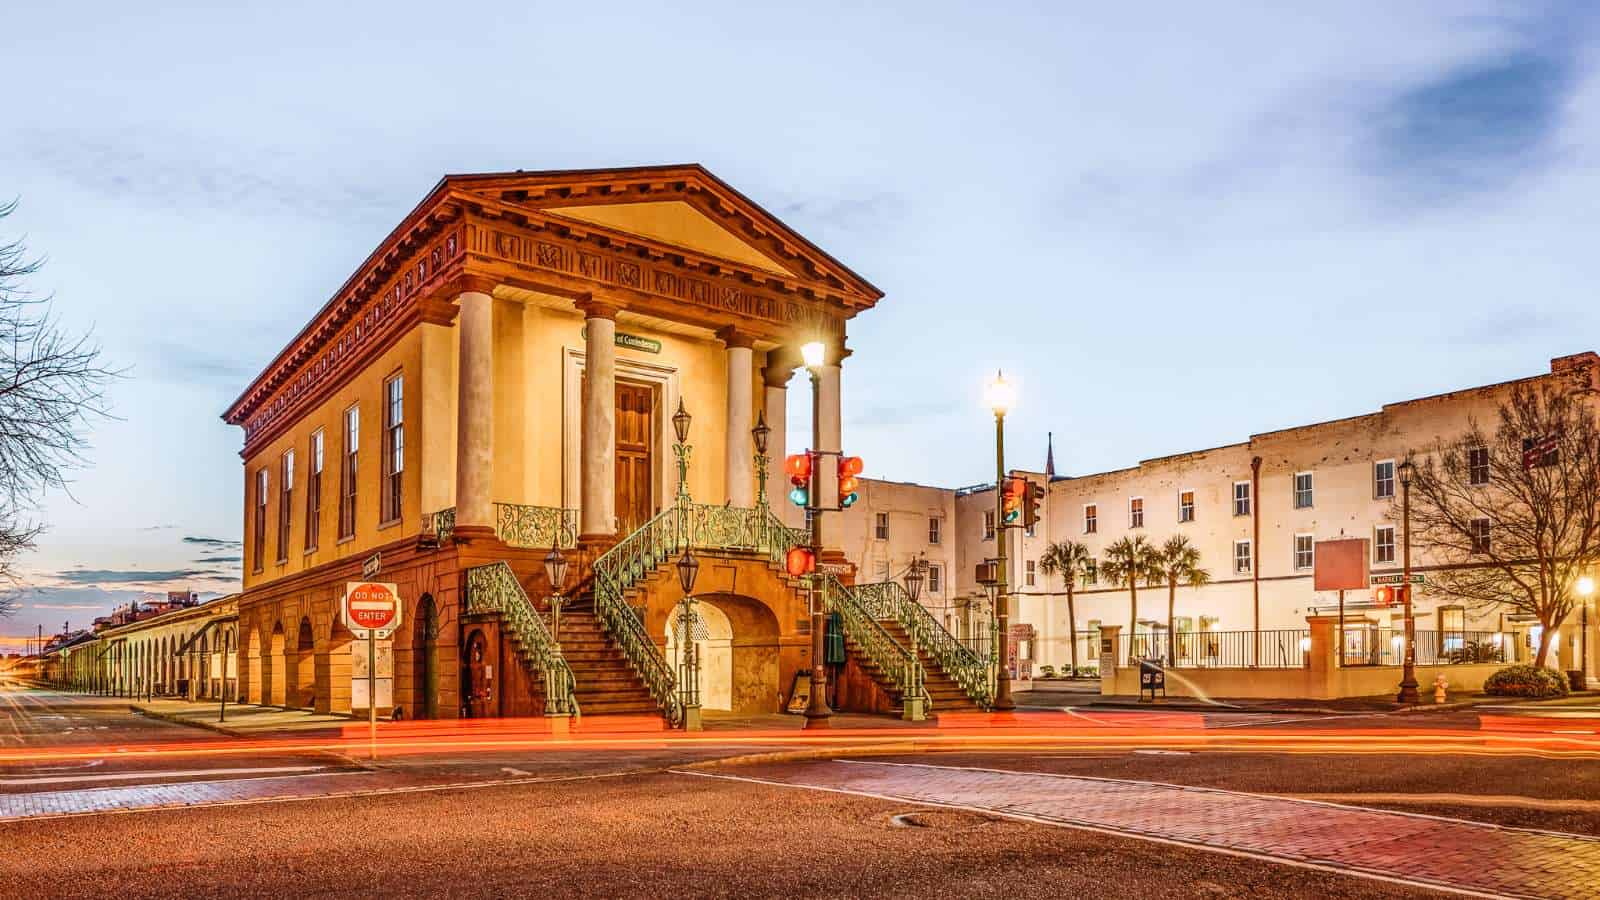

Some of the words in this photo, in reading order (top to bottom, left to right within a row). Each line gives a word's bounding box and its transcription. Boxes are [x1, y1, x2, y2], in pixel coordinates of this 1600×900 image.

[355, 592, 368, 600] DO
[372, 592, 392, 600] NOT
[359, 612, 386, 620] ENTER
